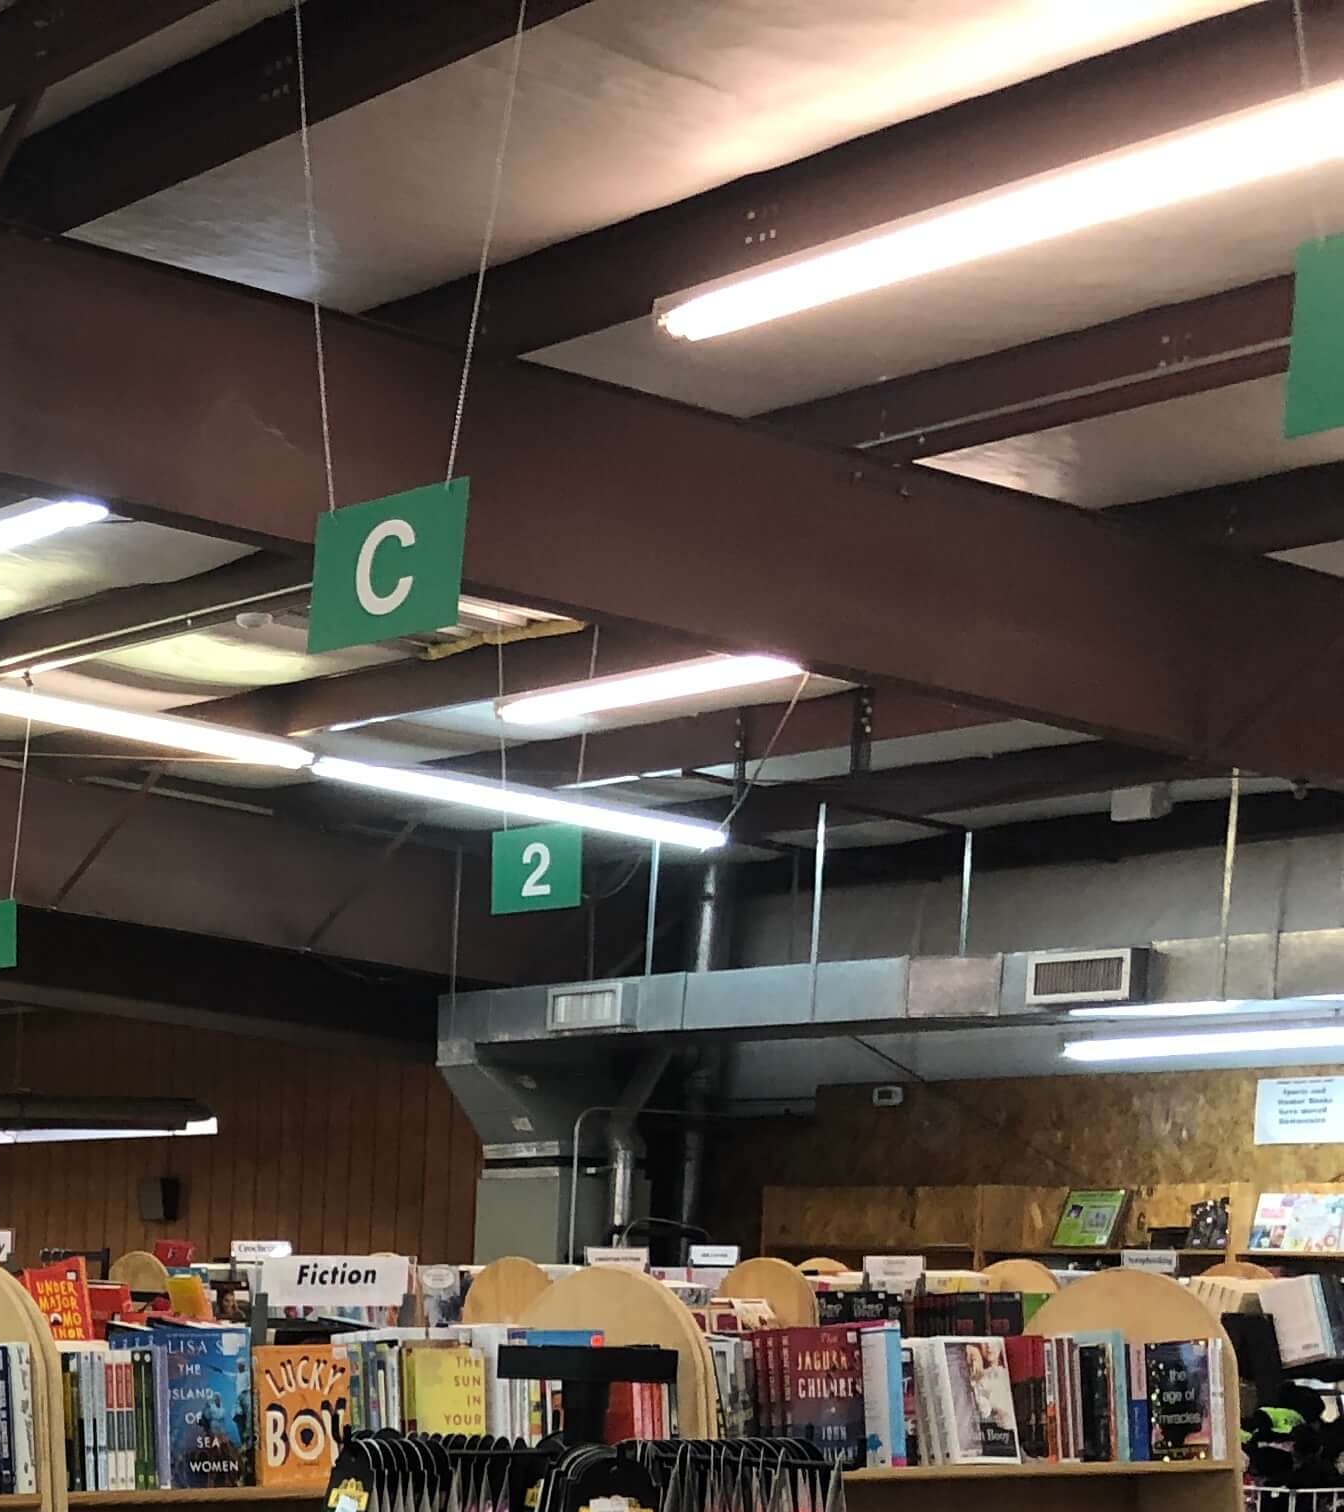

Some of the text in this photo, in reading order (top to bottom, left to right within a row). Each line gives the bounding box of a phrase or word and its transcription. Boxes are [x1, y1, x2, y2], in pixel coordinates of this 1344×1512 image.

[355, 518, 417, 616] C
[521, 841, 552, 897] 2
[297, 1263, 377, 1286] Fiction
[167, 1341, 207, 1356] LISA
[456, 1356, 480, 1369] THE
[178, 1364, 201, 1376] THE
[265, 1358, 345, 1399] LUCKY
[454, 1376, 481, 1388] SUN
[467, 1395, 481, 1407] IN
[444, 1414, 482, 1427] YOUR
[197, 1436, 220, 1449] SEA
[265, 1403, 348, 1468] BOY
[190, 1460, 239, 1474] WOMEN
